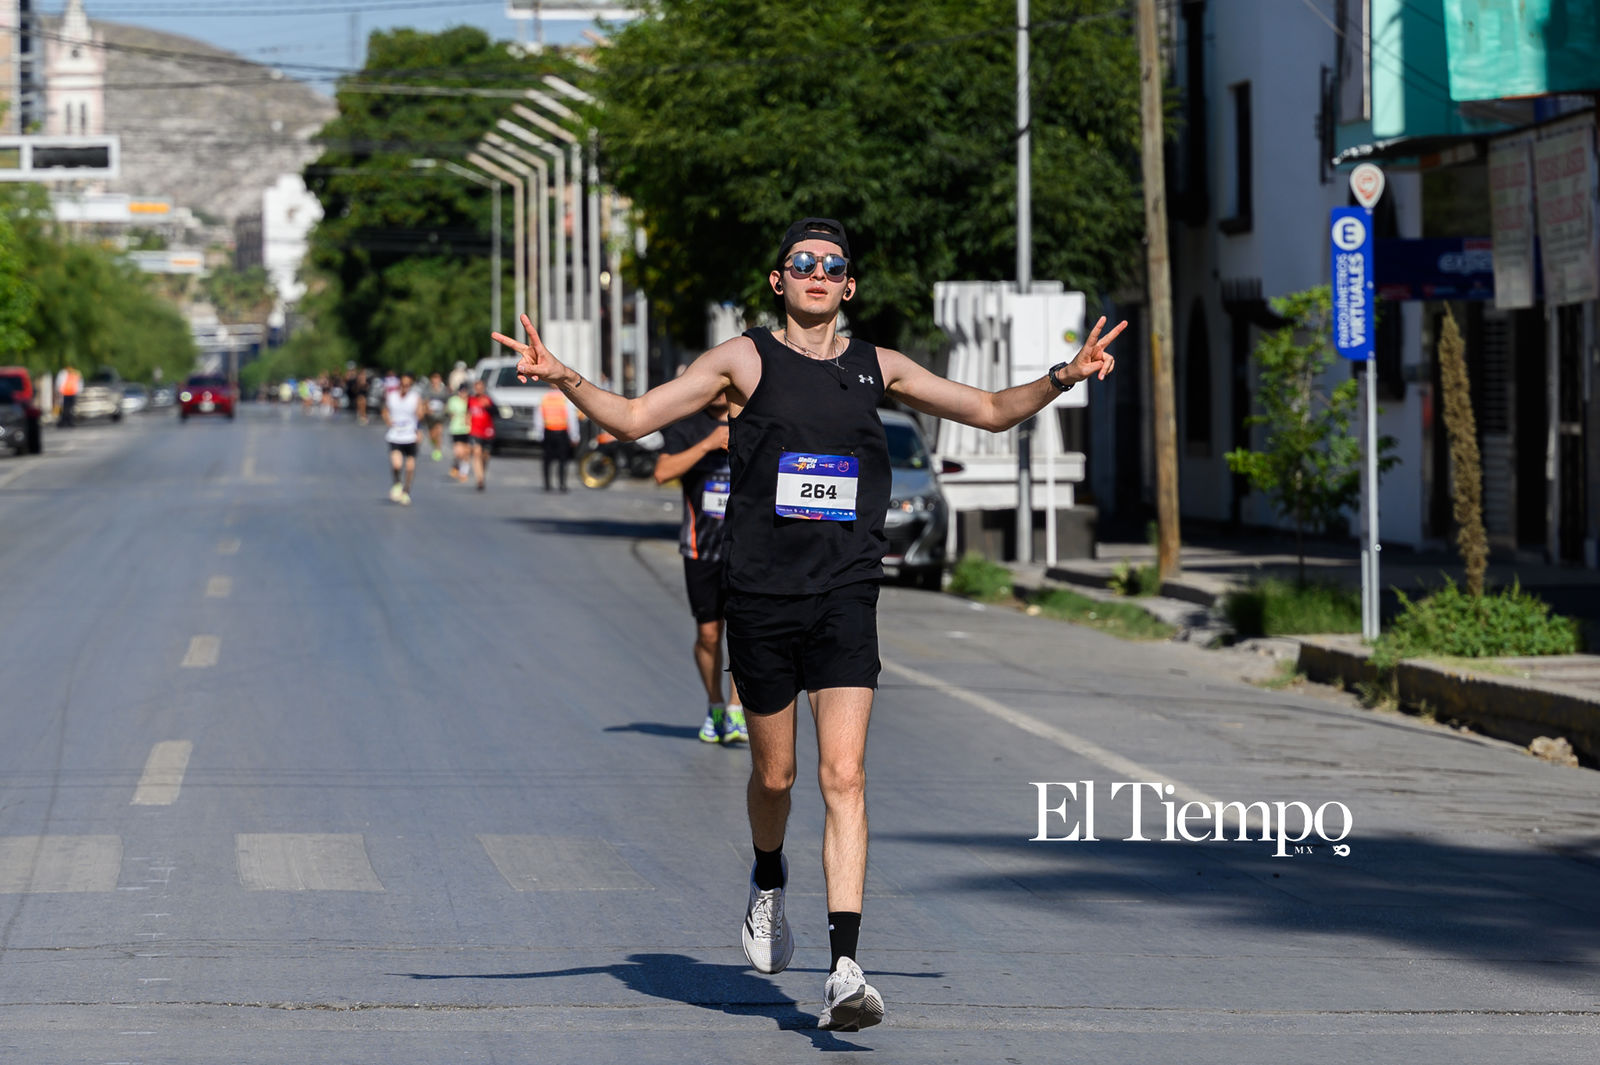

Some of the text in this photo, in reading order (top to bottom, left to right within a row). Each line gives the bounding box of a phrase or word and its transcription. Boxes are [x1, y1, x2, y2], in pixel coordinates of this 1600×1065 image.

[1342, 223, 1356, 244] E
[1349, 252, 1366, 348] VIRTUALES
[800, 483, 837, 500] 264
